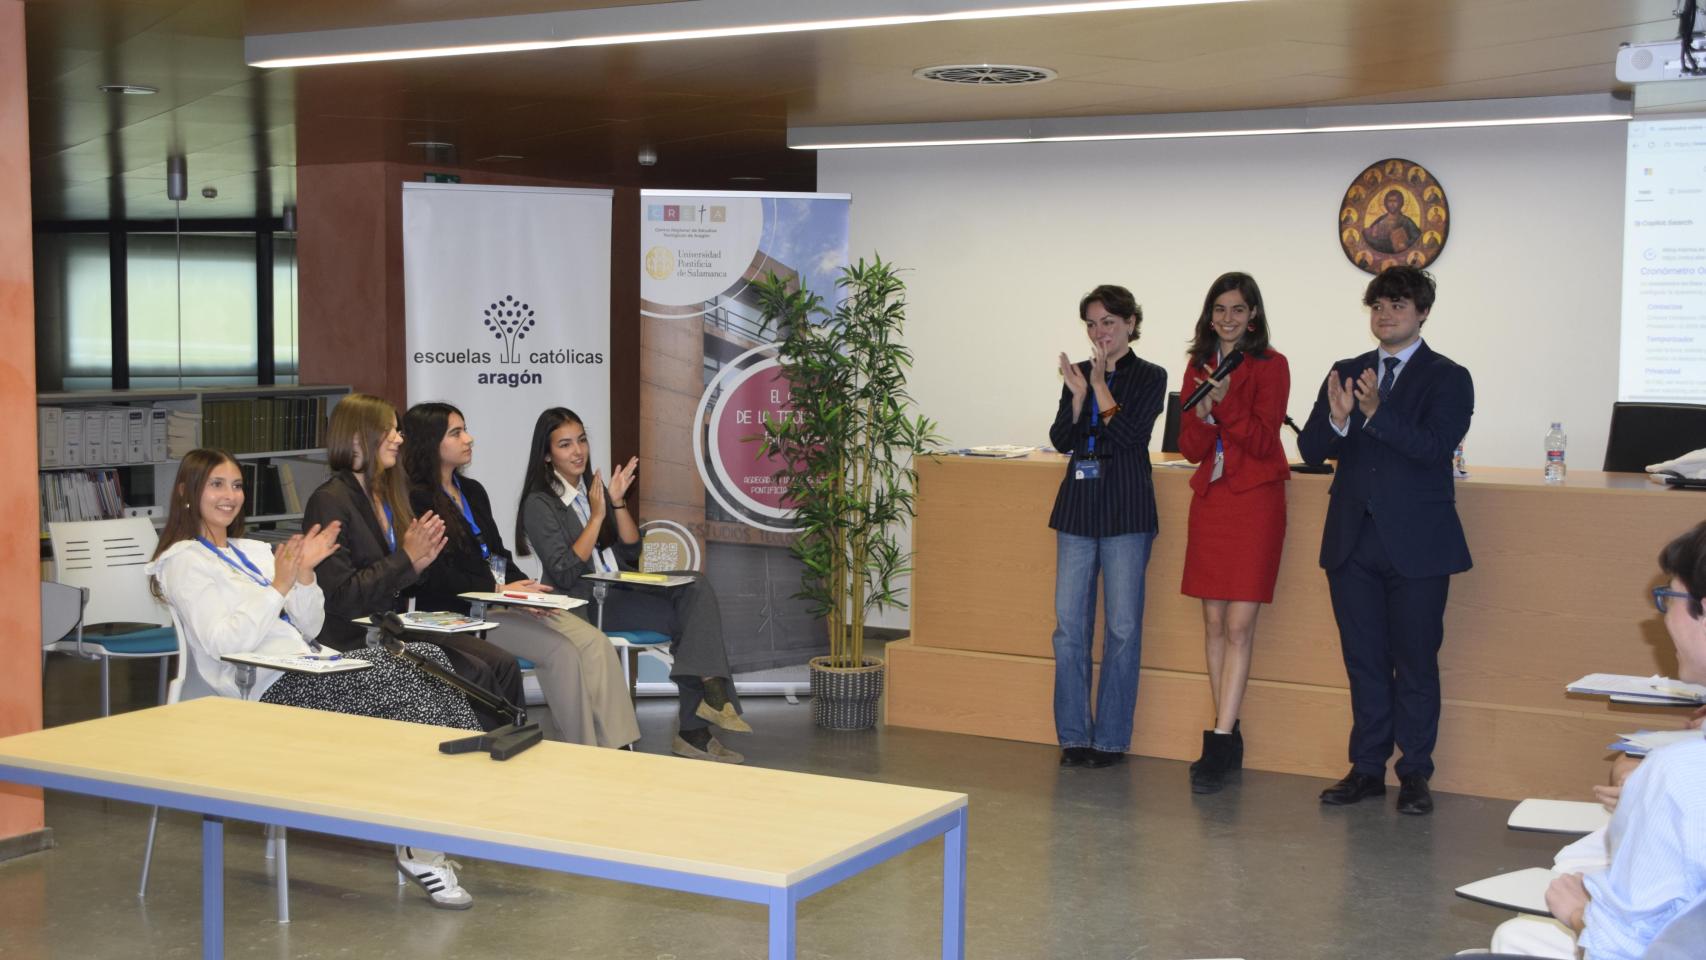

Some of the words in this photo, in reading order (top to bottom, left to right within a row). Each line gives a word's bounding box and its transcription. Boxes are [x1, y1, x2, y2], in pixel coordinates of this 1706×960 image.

[678, 248, 721, 258] Universidad
[678, 259, 712, 267] Pontificia
[677, 268, 687, 277] de
[687, 268, 727, 277] Salamanca
[413, 348, 492, 364] escuelas
[529, 348, 604, 364] católicas
[477, 369, 543, 388] aragón
[770, 389, 781, 404] EL
[736, 410, 752, 424] DE
